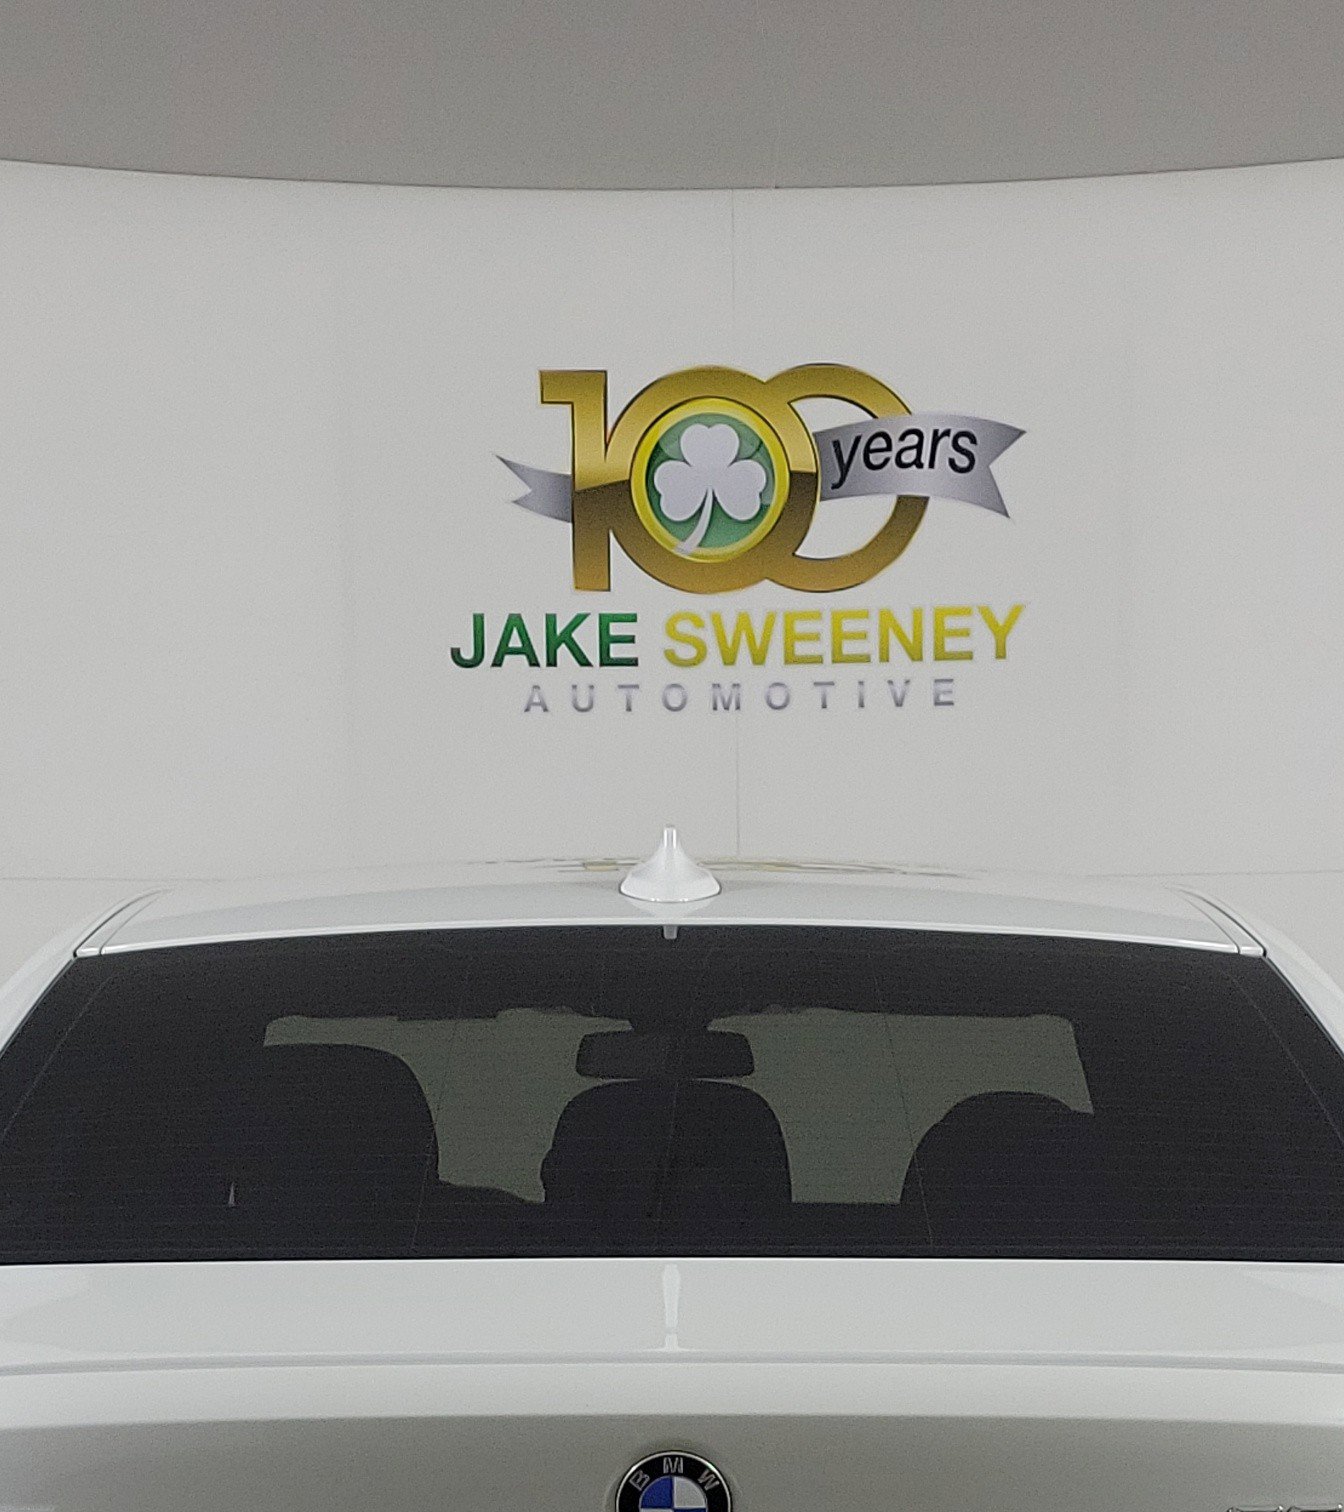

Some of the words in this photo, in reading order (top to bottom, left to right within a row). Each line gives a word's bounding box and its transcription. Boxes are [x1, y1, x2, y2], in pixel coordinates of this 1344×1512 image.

[538, 363, 930, 594] 100
[830, 426, 977, 489] years
[450, 613, 639, 668] JAKE
[663, 604, 1027, 668] SWEENEY
[523, 678, 956, 713] AUTOMOTIVE
[629, 1457, 720, 1491] BMW
